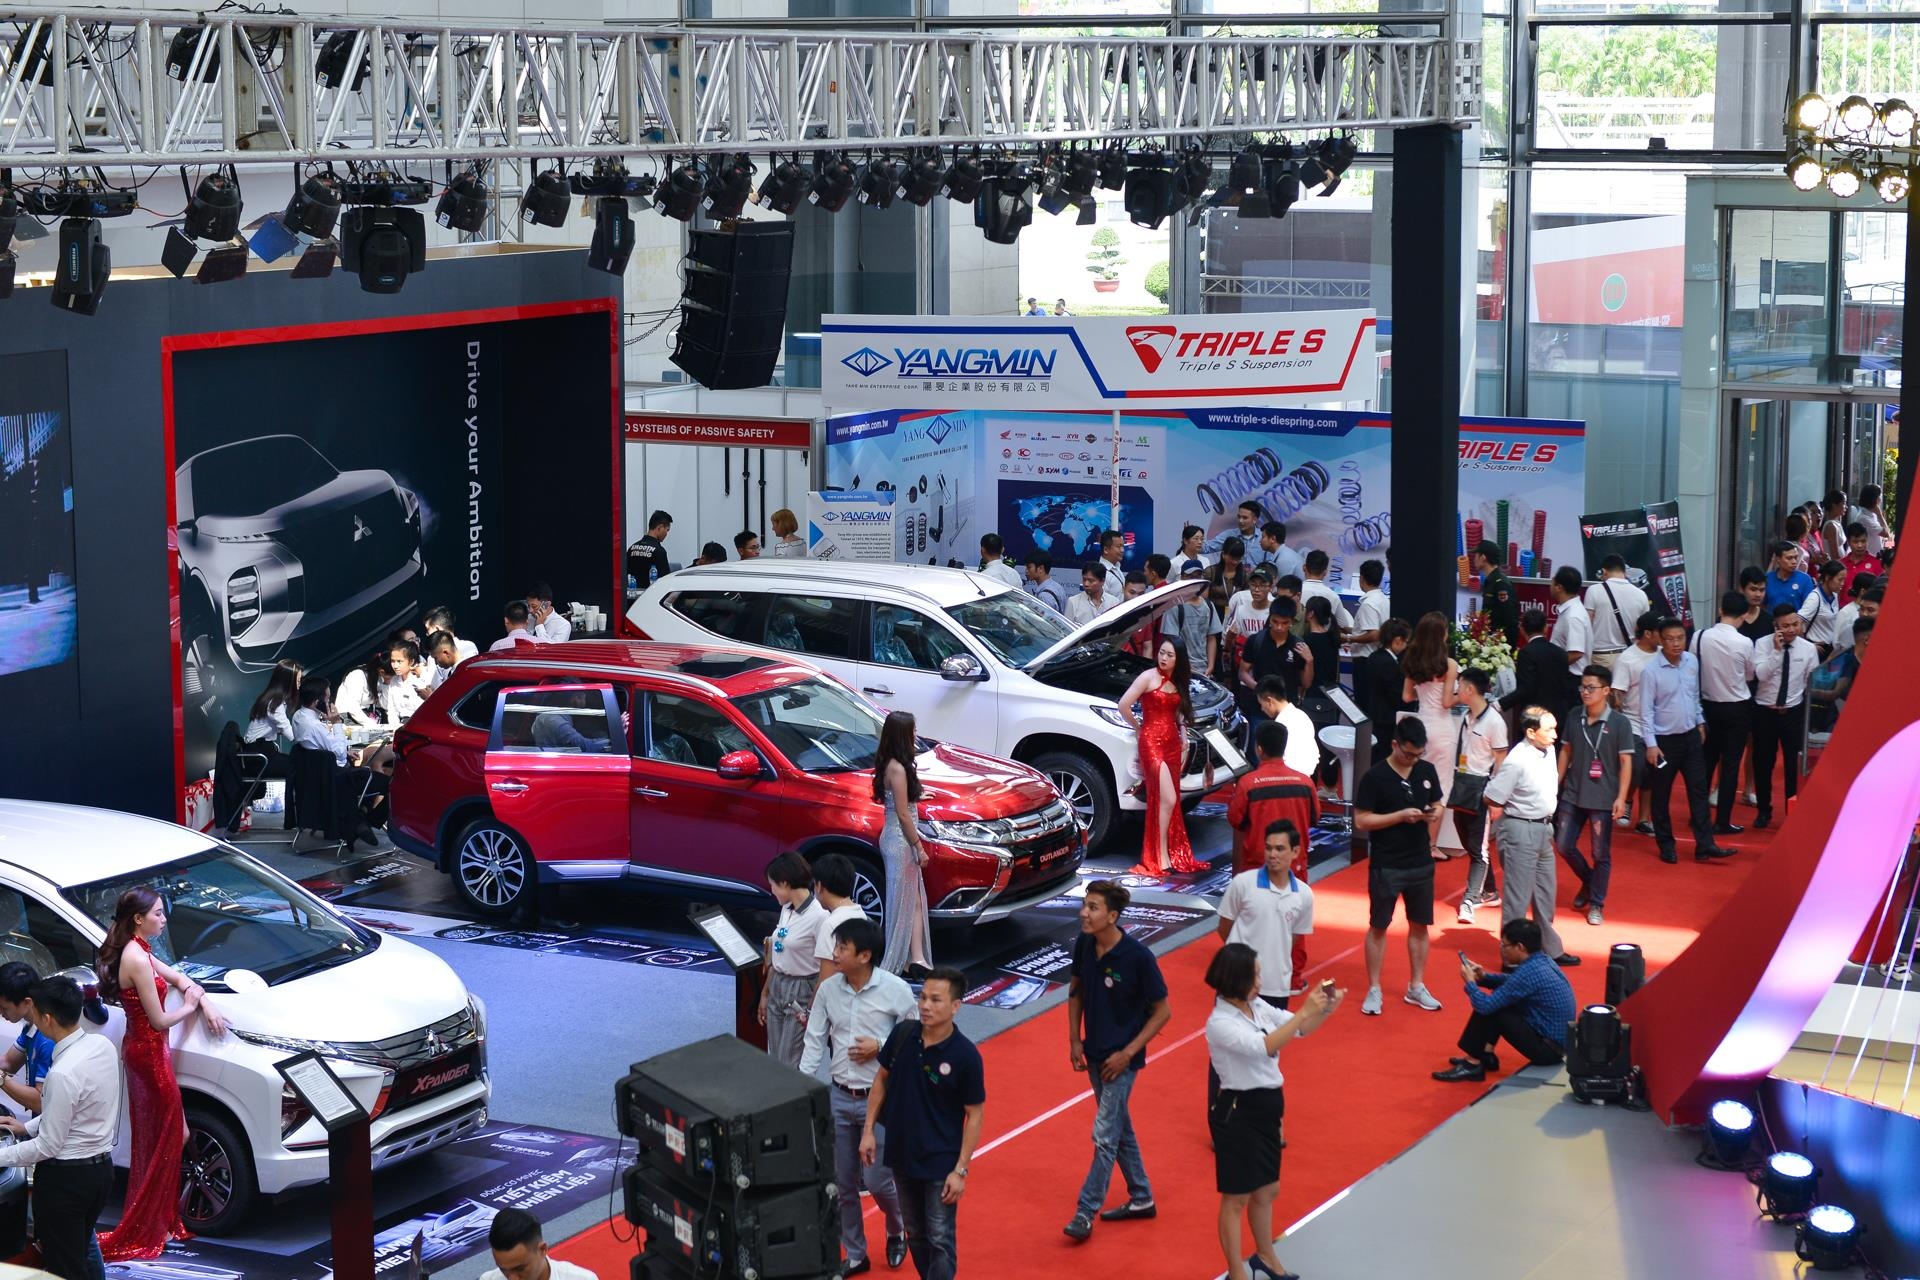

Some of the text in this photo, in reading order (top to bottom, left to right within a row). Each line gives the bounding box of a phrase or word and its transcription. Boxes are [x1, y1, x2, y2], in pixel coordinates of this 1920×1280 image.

[1175, 328, 1327, 358] TRIPLE S
[894, 348, 1058, 377] YANGMIN
[1178, 358, 1313, 373] Triple S Suspension
[836, 419, 889, 437] www.yangmin.com.tw
[1208, 412, 1338, 428] www.triple-s-diespring.com
[632, 424, 677, 435] SYSTEMS
[679, 425, 692, 435] OF
[694, 426, 735, 437] PASSIVE
[737, 428, 775, 439] SAFETY
[903, 418, 967, 443] YANG MIN
[1533, 443, 1559, 464] S
[464, 341, 483, 601] Drive your Ambition
[1483, 462, 1545, 473] Suspension
[840, 511, 892, 521] YANGMIN
[1657, 518, 1674, 530] TRIPLE
[1592, 524, 1617, 535] TRIPLE
[1040, 846, 1070, 863] OUTLANDER
[1016, 949, 1070, 972] DYNAMIC
[1033, 958, 1074, 977] SHIELD
[411, 1063, 470, 1094] XPANDER
[493, 1169, 573, 1203] TIẾT KIỆM
[557, 1172, 596, 1191] LIỆU
